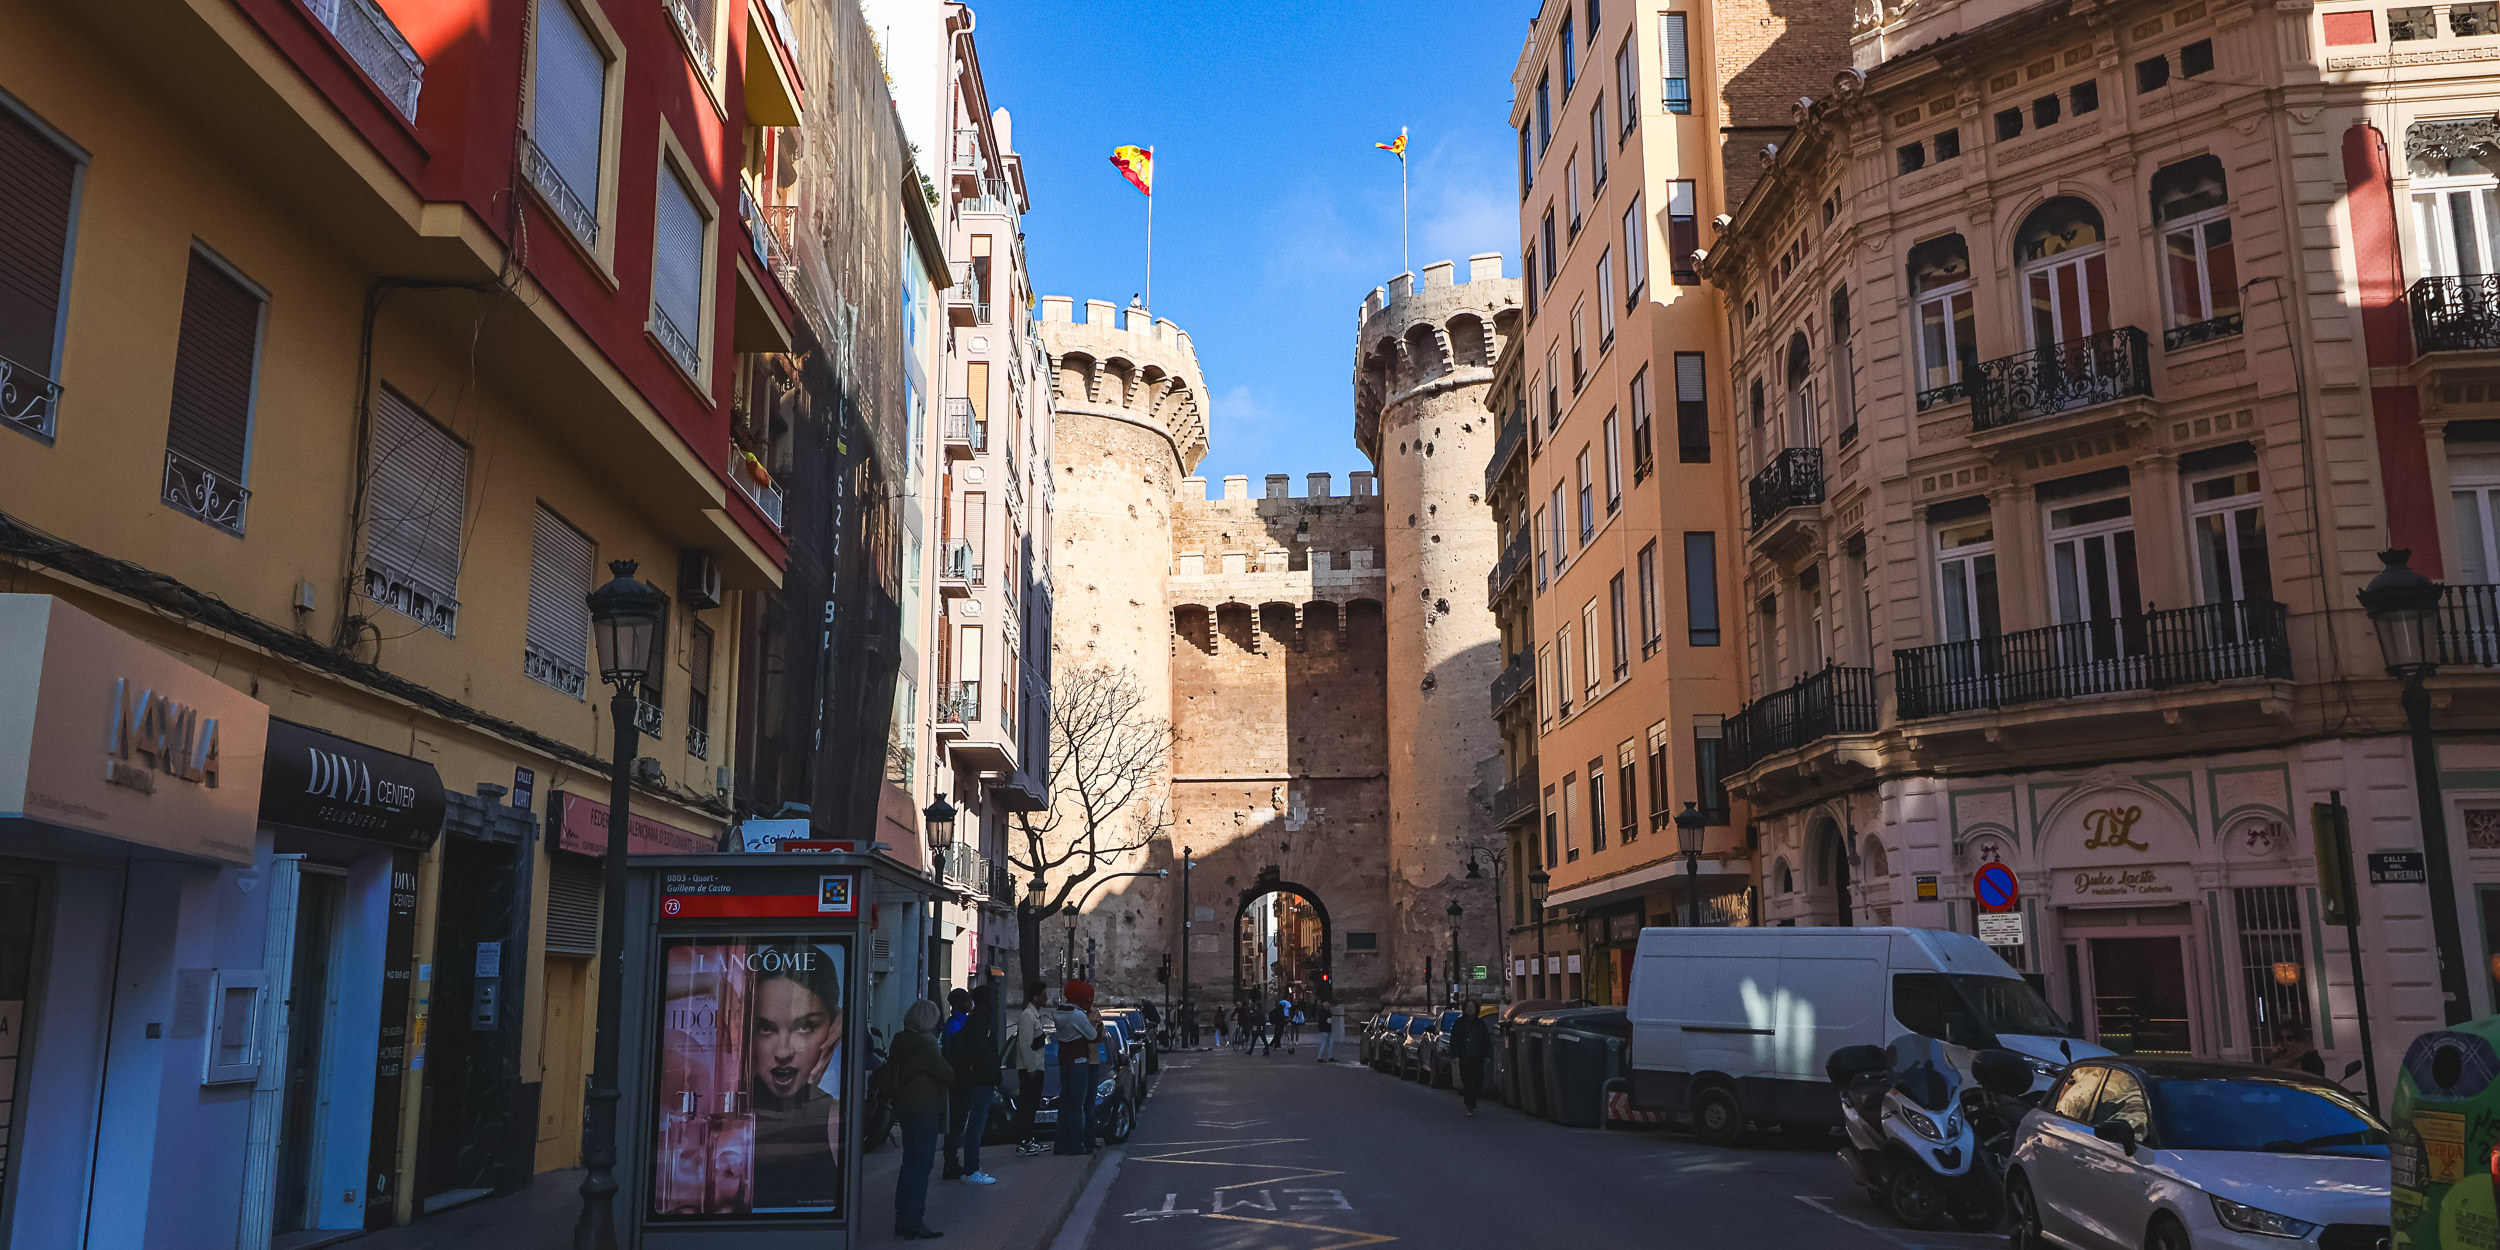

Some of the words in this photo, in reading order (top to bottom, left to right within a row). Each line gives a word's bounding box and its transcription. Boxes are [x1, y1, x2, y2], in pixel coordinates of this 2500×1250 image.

[305, 747, 371, 806] DIVA
[377, 781, 415, 808] CENTER
[517, 771, 532, 785] CALLE
[590, 808, 610, 829] FEDER
[628, 819, 659, 843] ALENCIANA
[2384, 855, 2407, 863] CALLE
[395, 872, 416, 891] DIVA
[667, 874, 687, 882] 0803
[693, 874, 714, 883] Quart
[2074, 871, 2114, 894] Dulce
[2118, 869, 2156, 888] Lacito
[667, 884, 696, 893] Guillem
[697, 884, 707, 893] de
[708, 884, 731, 893] Castro
[393, 893, 415, 908] CENTER
[667, 902, 678, 911] 73
[698, 949, 817, 973] LANCÔME
[1122, 1188, 1354, 1219] EMT
